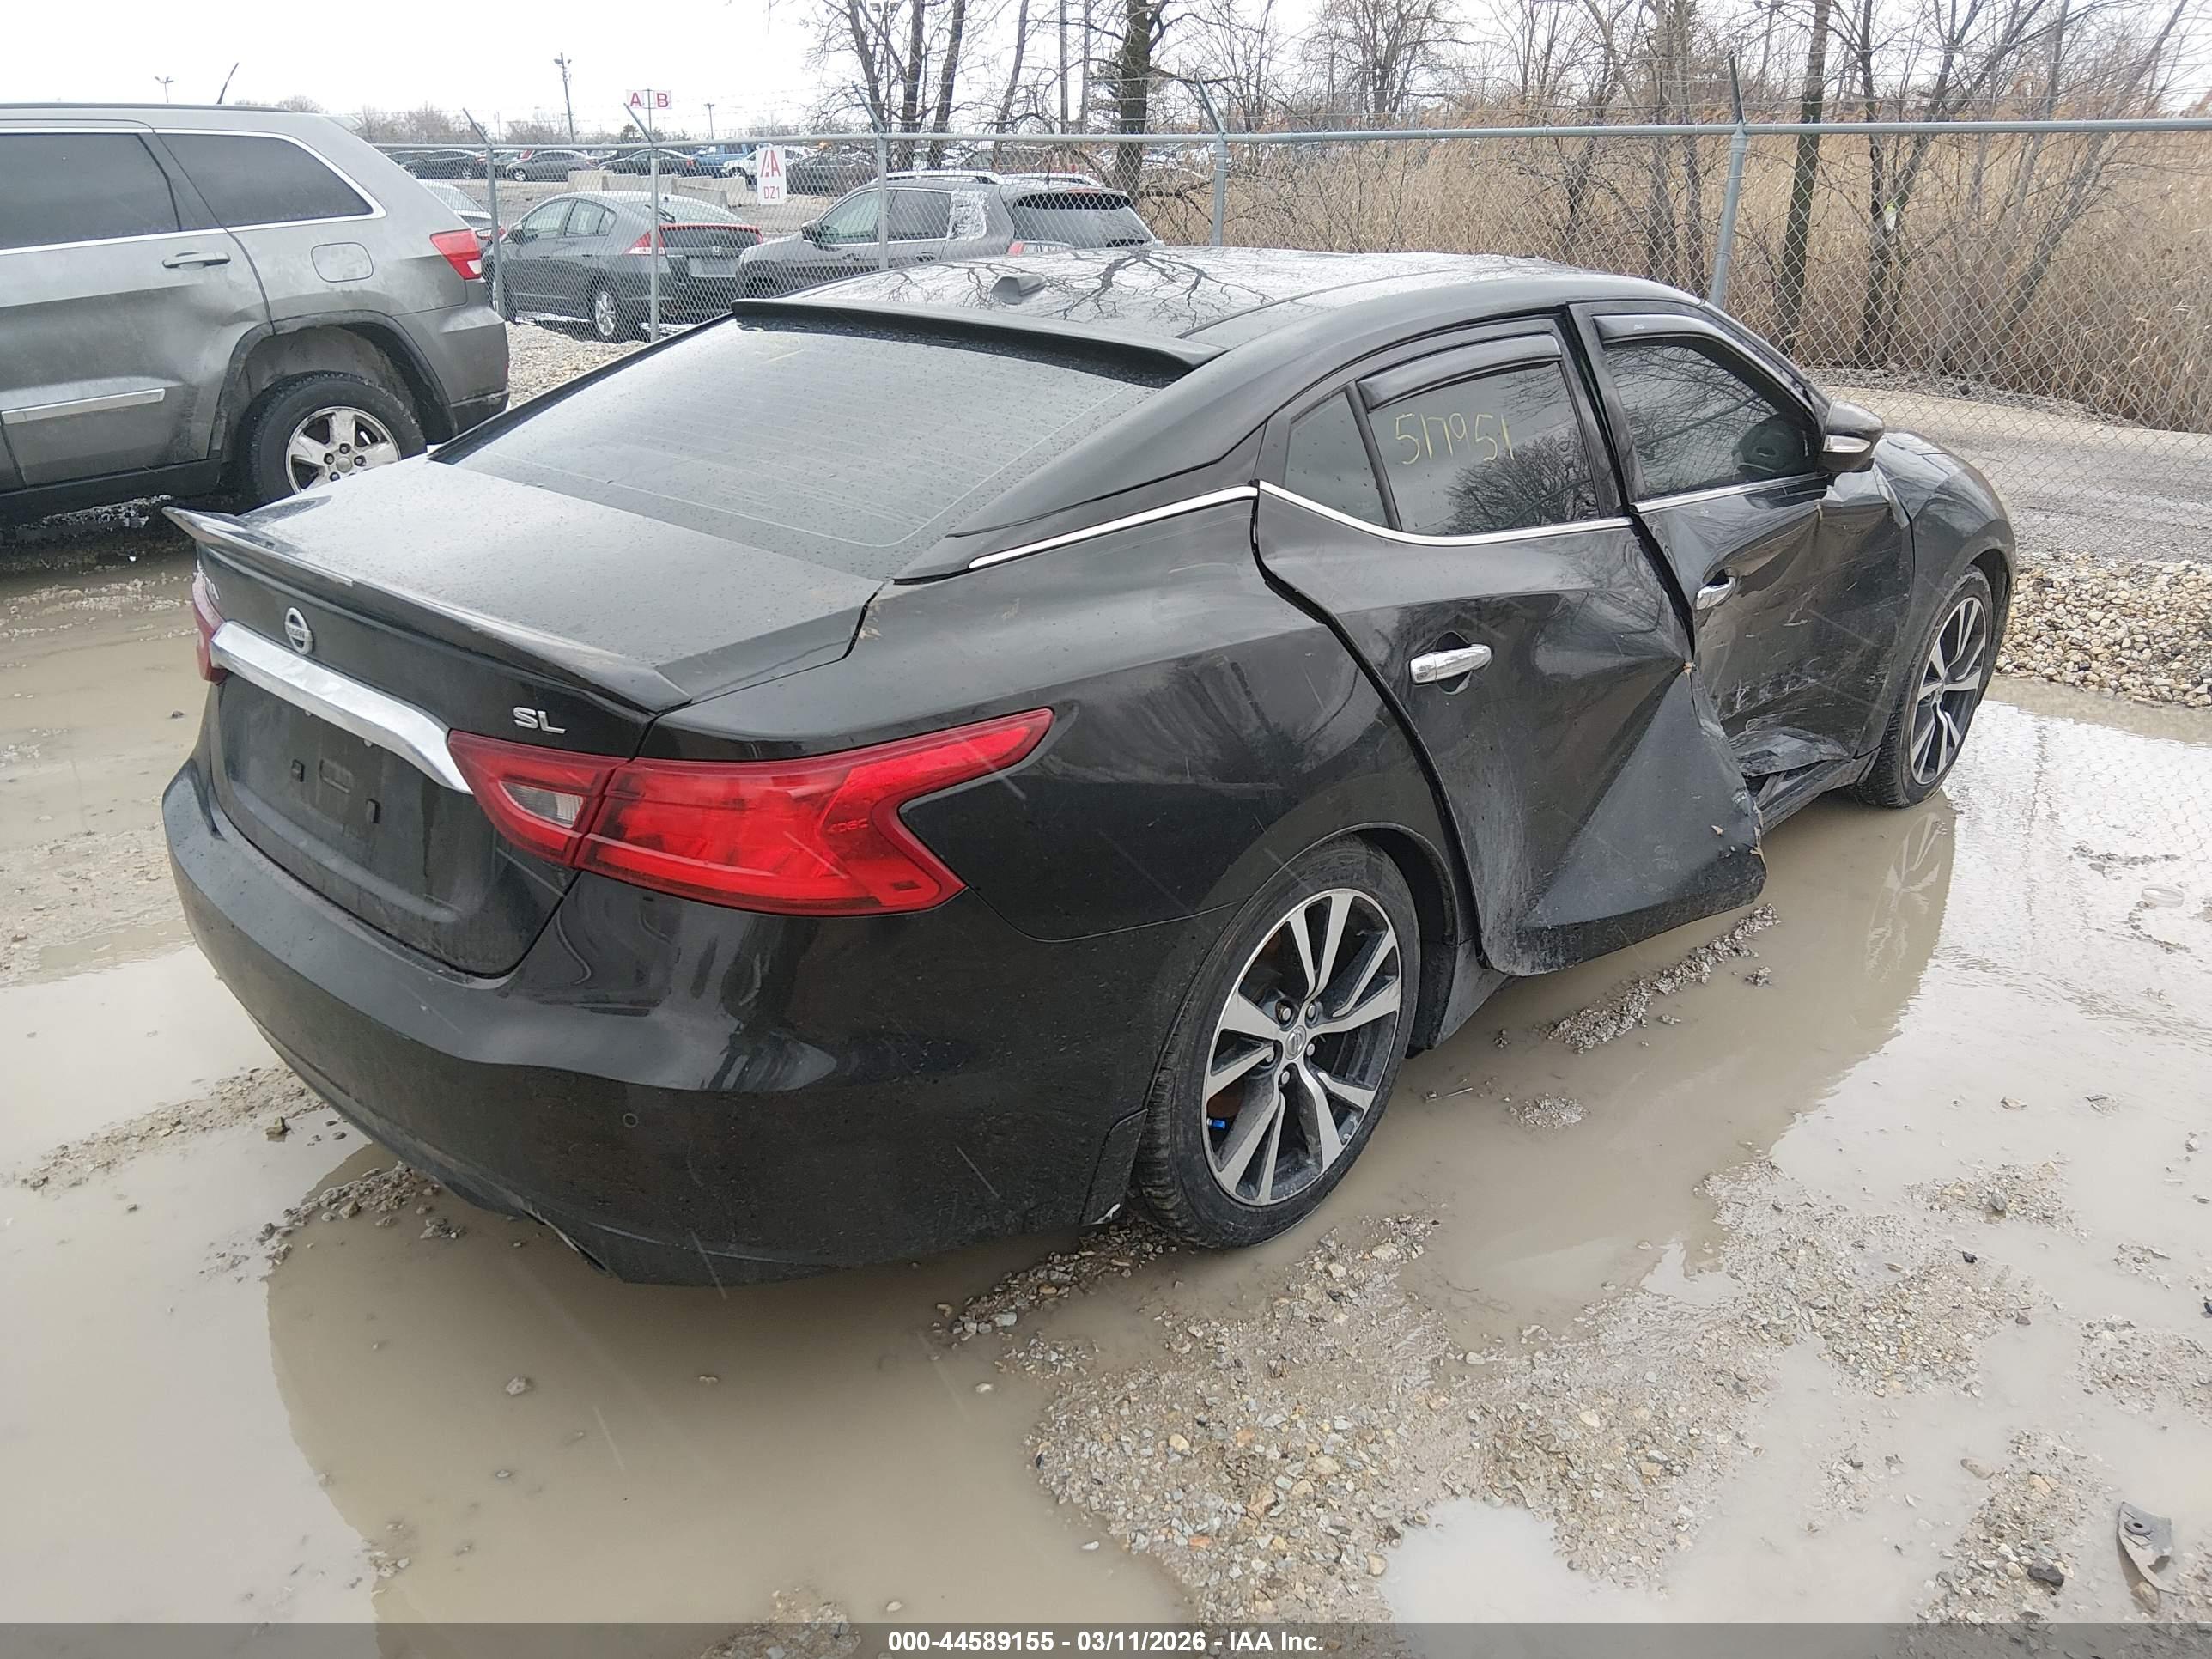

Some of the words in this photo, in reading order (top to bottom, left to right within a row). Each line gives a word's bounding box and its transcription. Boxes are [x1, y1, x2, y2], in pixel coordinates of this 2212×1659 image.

[630, 92, 642, 107] A
[657, 93, 669, 107] B
[763, 185, 781, 200] DZ1
[1395, 412, 1515, 465] 517951
[514, 707, 568, 734] SL
